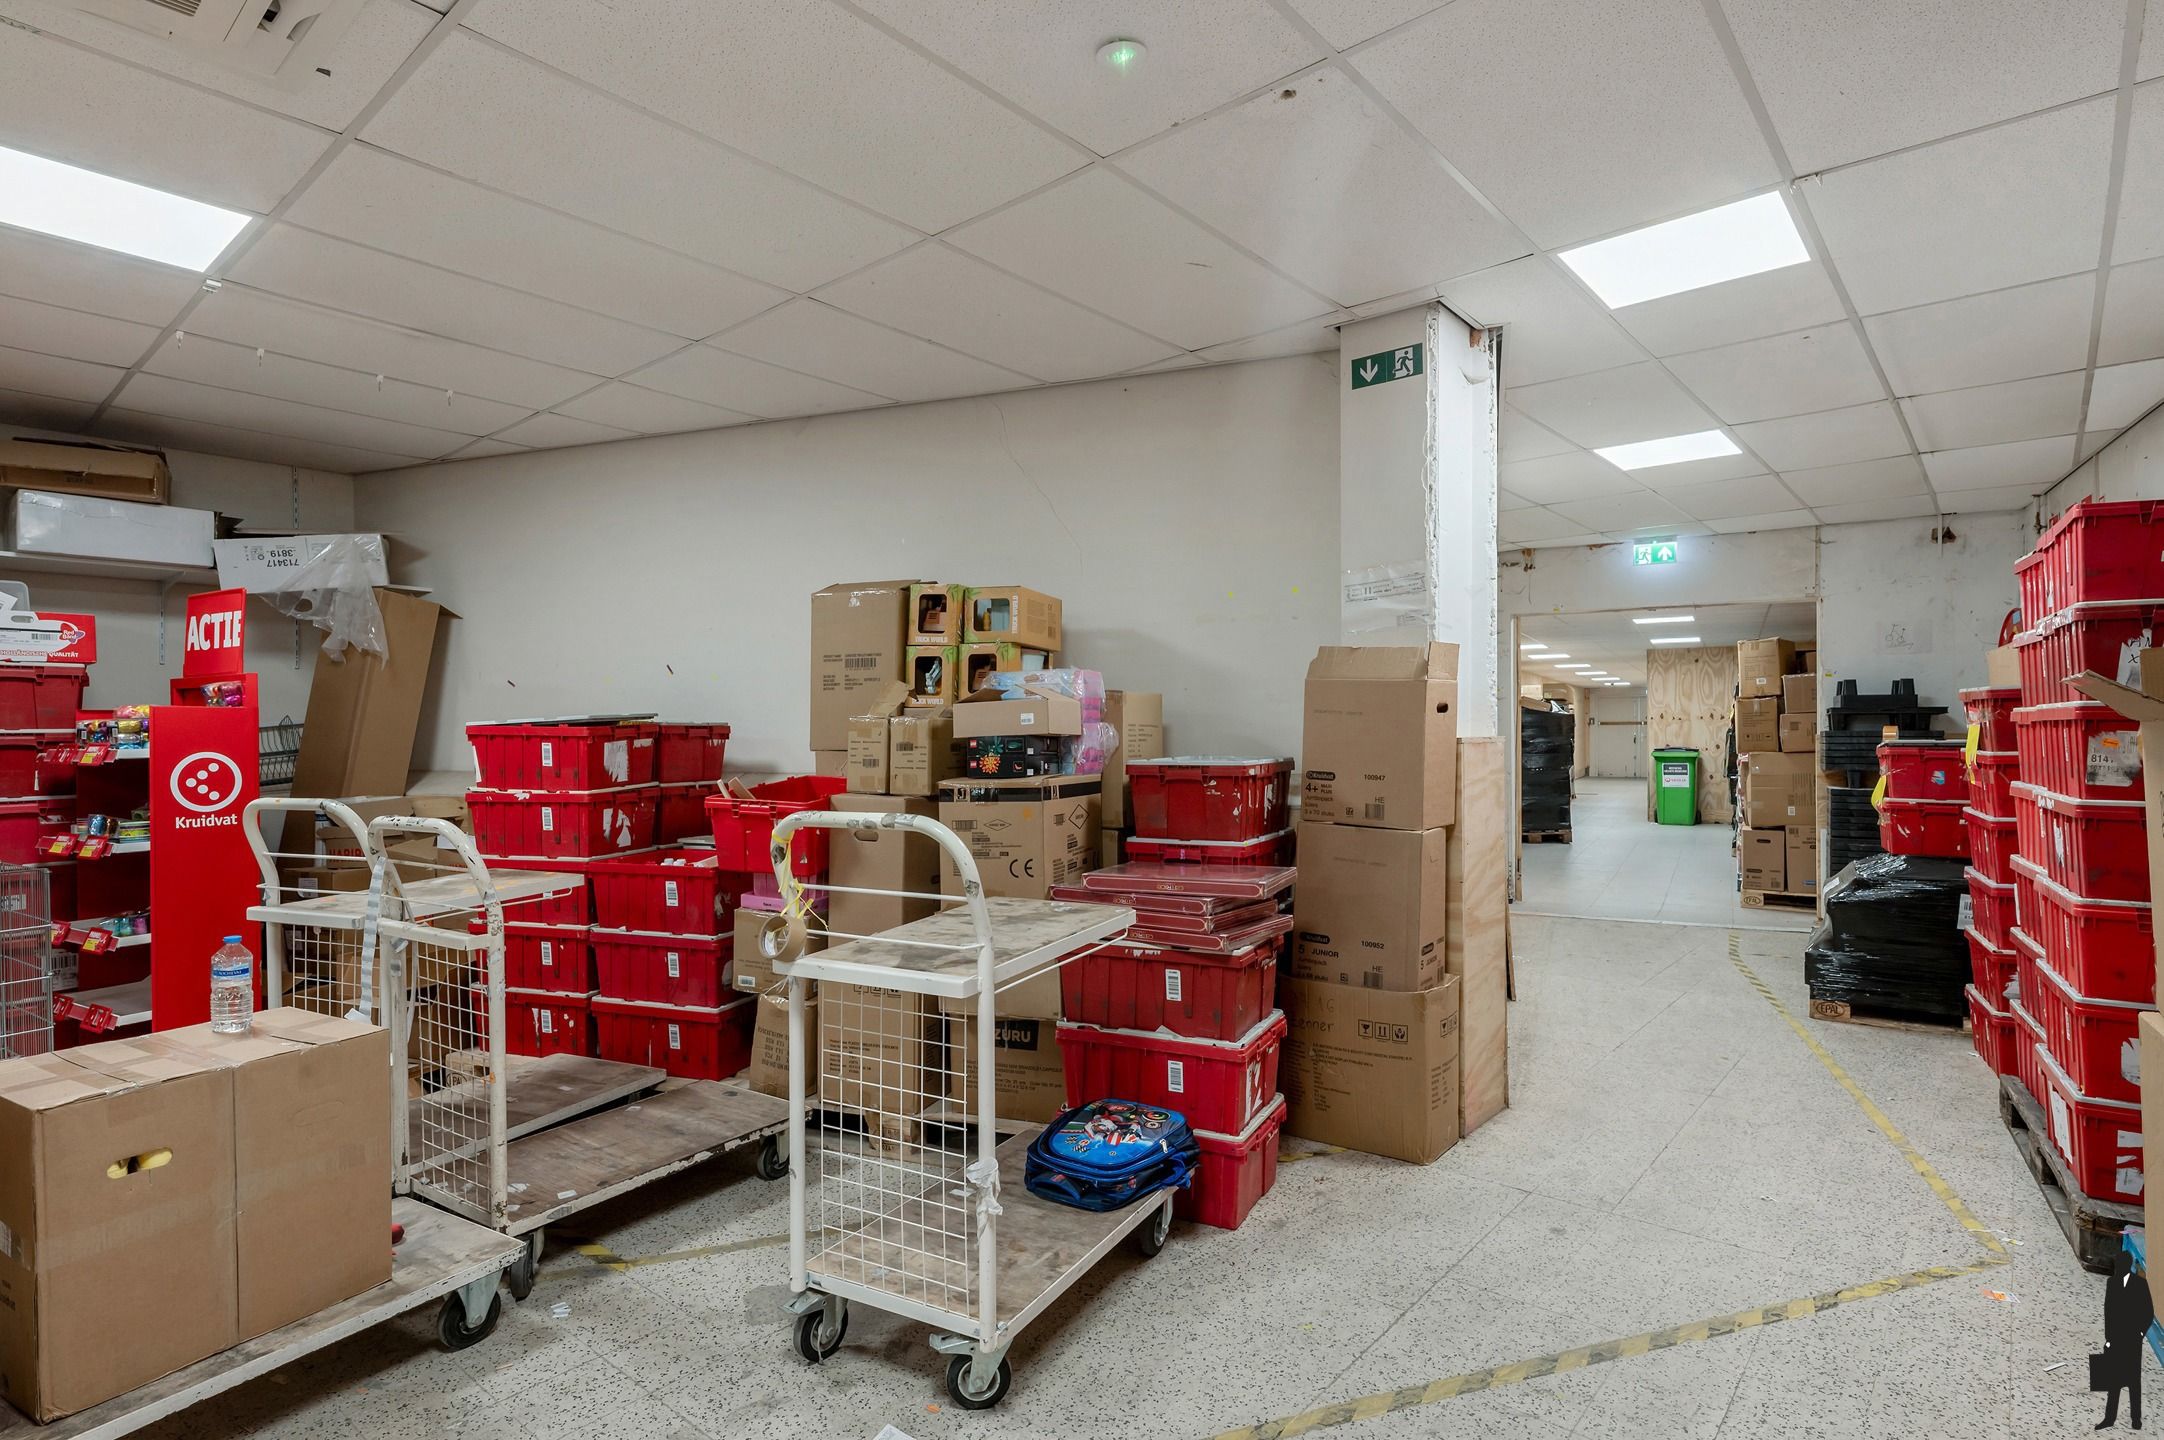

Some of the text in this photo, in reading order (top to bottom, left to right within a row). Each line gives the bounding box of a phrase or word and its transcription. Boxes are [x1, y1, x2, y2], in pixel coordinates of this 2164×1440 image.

[266, 558, 299, 568] 713417
[187, 610, 242, 652] ACTIE
[175, 813, 238, 829] Kruidvat
[1311, 948, 1340, 958] JUNIOR
[1820, 1004, 1840, 1014] EPAL
